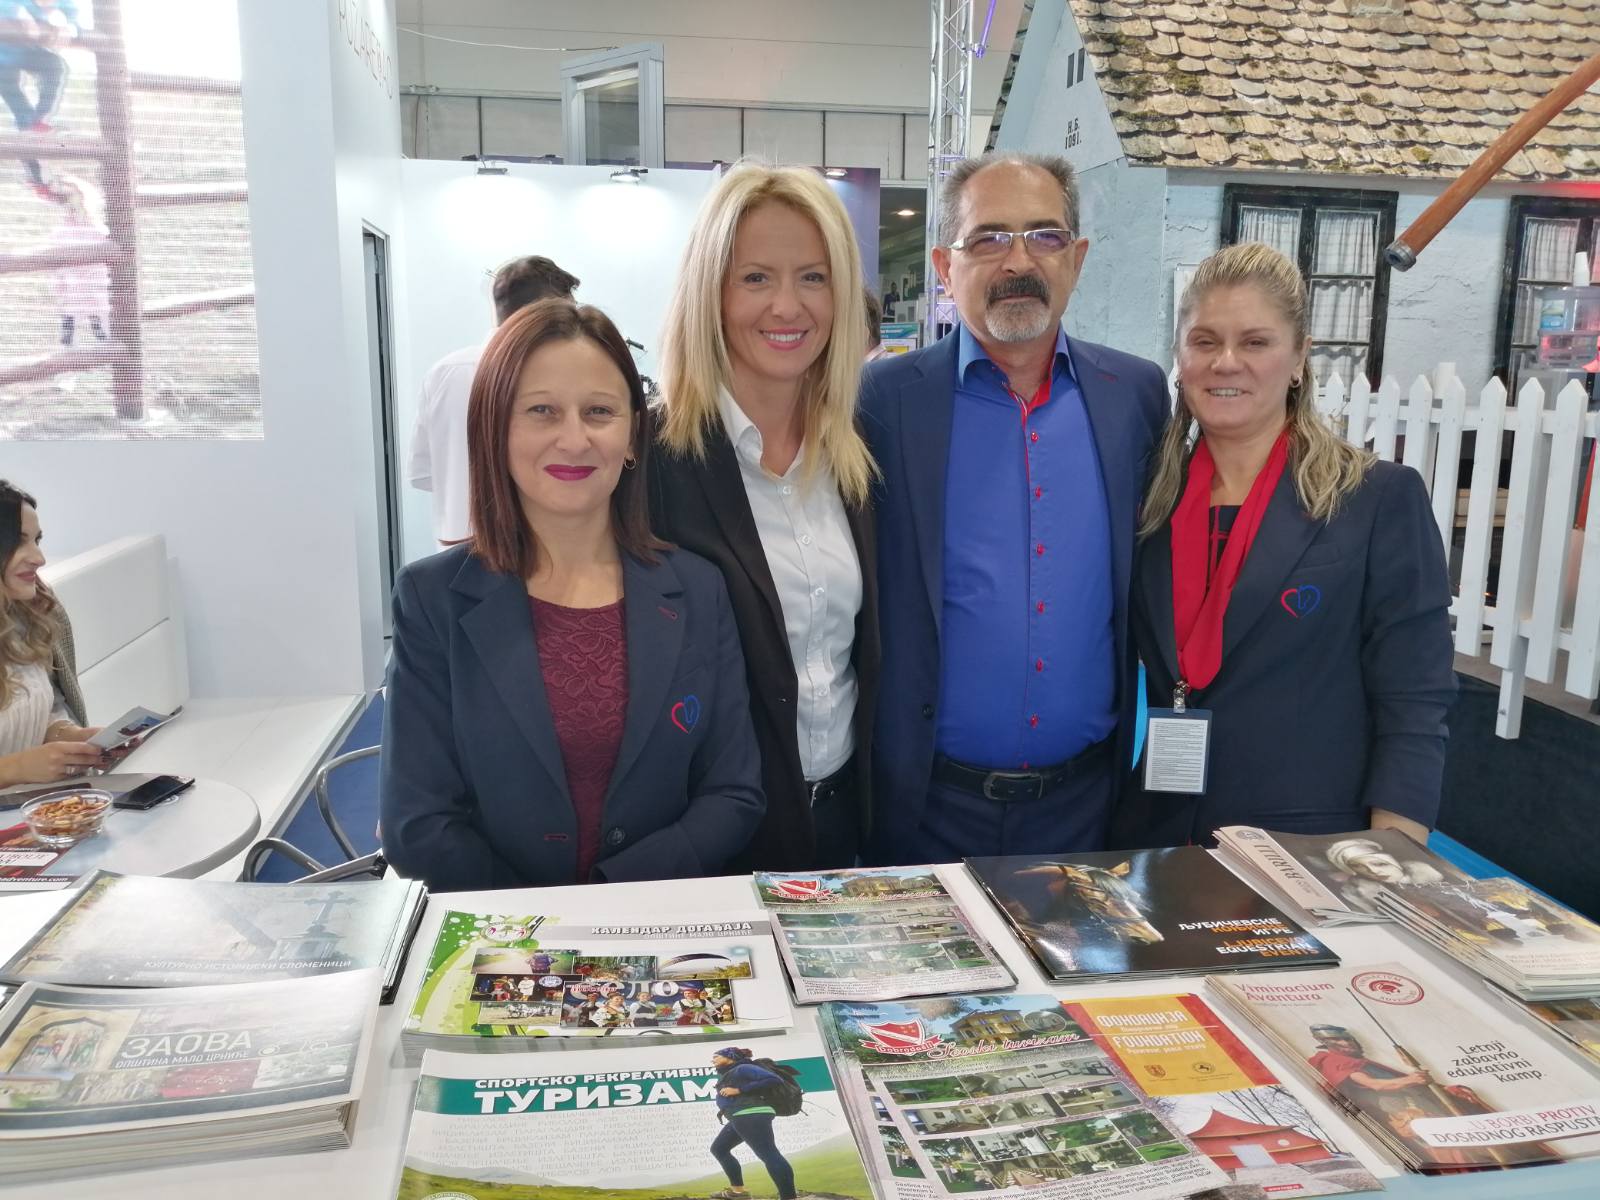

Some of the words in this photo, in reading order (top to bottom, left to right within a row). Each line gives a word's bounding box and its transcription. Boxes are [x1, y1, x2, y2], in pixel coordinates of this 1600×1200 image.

[591, 925, 671, 935] КАЛЕНДАР
[676, 922, 752, 933] ДОГАЂАЈА
[1179, 918, 1281, 930] ЉУБИЧЕВСКЕ
[1216, 943, 1312, 954] EQUESTRIAN
[1261, 948, 1319, 957] EVENTS
[279, 960, 351, 969] СПОМЕНИЦИ
[1234, 982, 1335, 994] Viminacium
[1246, 992, 1323, 1002] Avantura
[121, 1030, 252, 1058] ЗАОВА
[926, 1039, 998, 1059] Seoski
[1002, 1033, 1080, 1050] turizam
[1112, 1030, 1206, 1048] FOUNDATION
[1456, 1040, 1506, 1054] Letnji
[115, 1057, 169, 1069] ОПШТИНА
[172, 1055, 203, 1065] МАЛО
[1451, 1051, 1519, 1066] zabavno
[1447, 1058, 1532, 1078] edukativni
[475, 1076, 577, 1089] СПОРТСКО
[584, 1067, 718, 1084] РЕКРЕАТИВНИ
[474, 1078, 719, 1114] ТУРИЗАМ
[1487, 1114, 1535, 1129] BORBI
[1536, 1105, 1597, 1121] PROTIV
[1433, 1127, 1525, 1144] DOSADNOG
[1526, 1116, 1600, 1137] RASPUSTA
